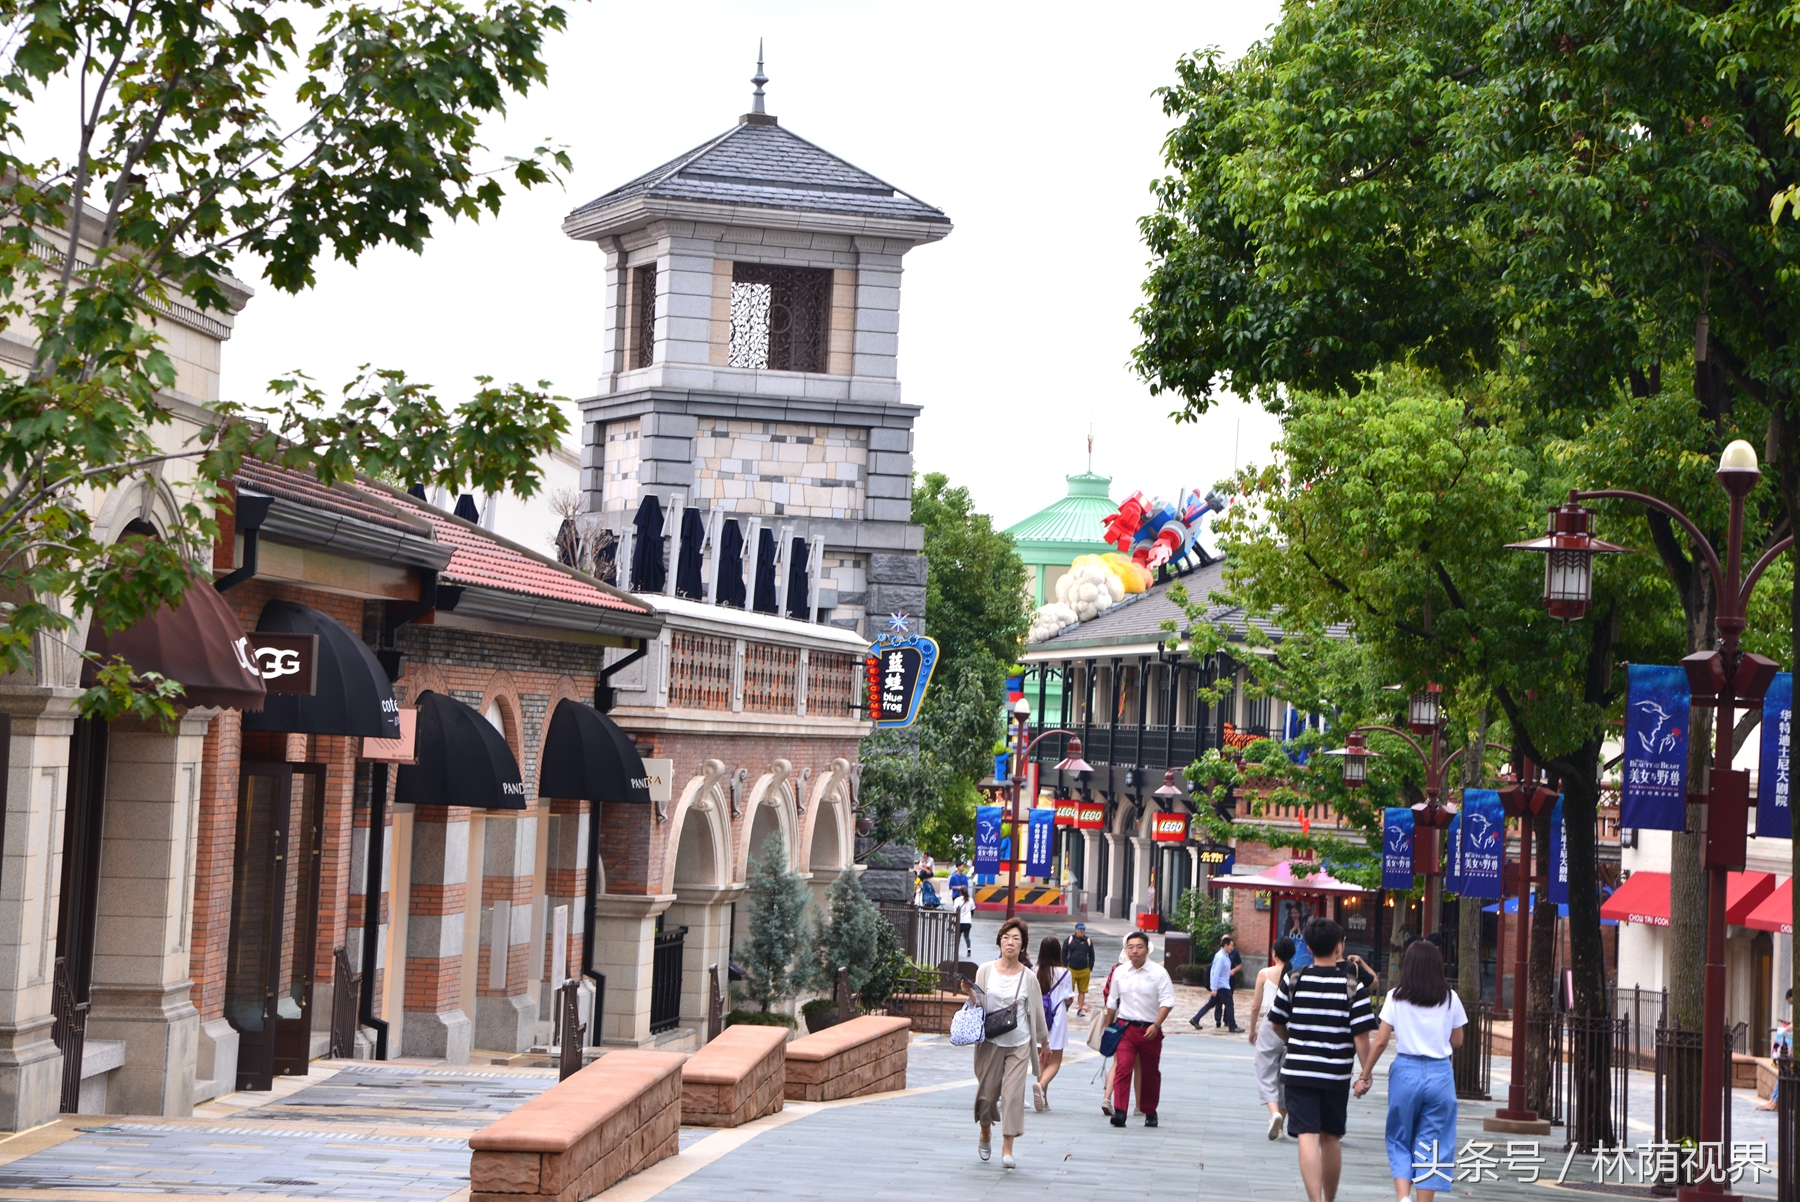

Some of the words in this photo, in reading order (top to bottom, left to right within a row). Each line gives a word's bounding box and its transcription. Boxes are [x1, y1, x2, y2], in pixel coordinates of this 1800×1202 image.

[253, 646, 301, 680] GG
[885, 651, 905, 691] 蓝蛙
[866, 660, 879, 717] WELCOME
[883, 691, 903, 702] blue
[882, 701, 902, 713] frog
[1775, 709, 1792, 808] 华特迪士尼大剧院
[1629, 768, 1680, 787] 美女与野兽
[503, 782, 525, 795] PAND
[1080, 810, 1103, 821] LEGO
[1159, 821, 1184, 833] LEGO
[1654, 916, 1669, 927] FOOK
